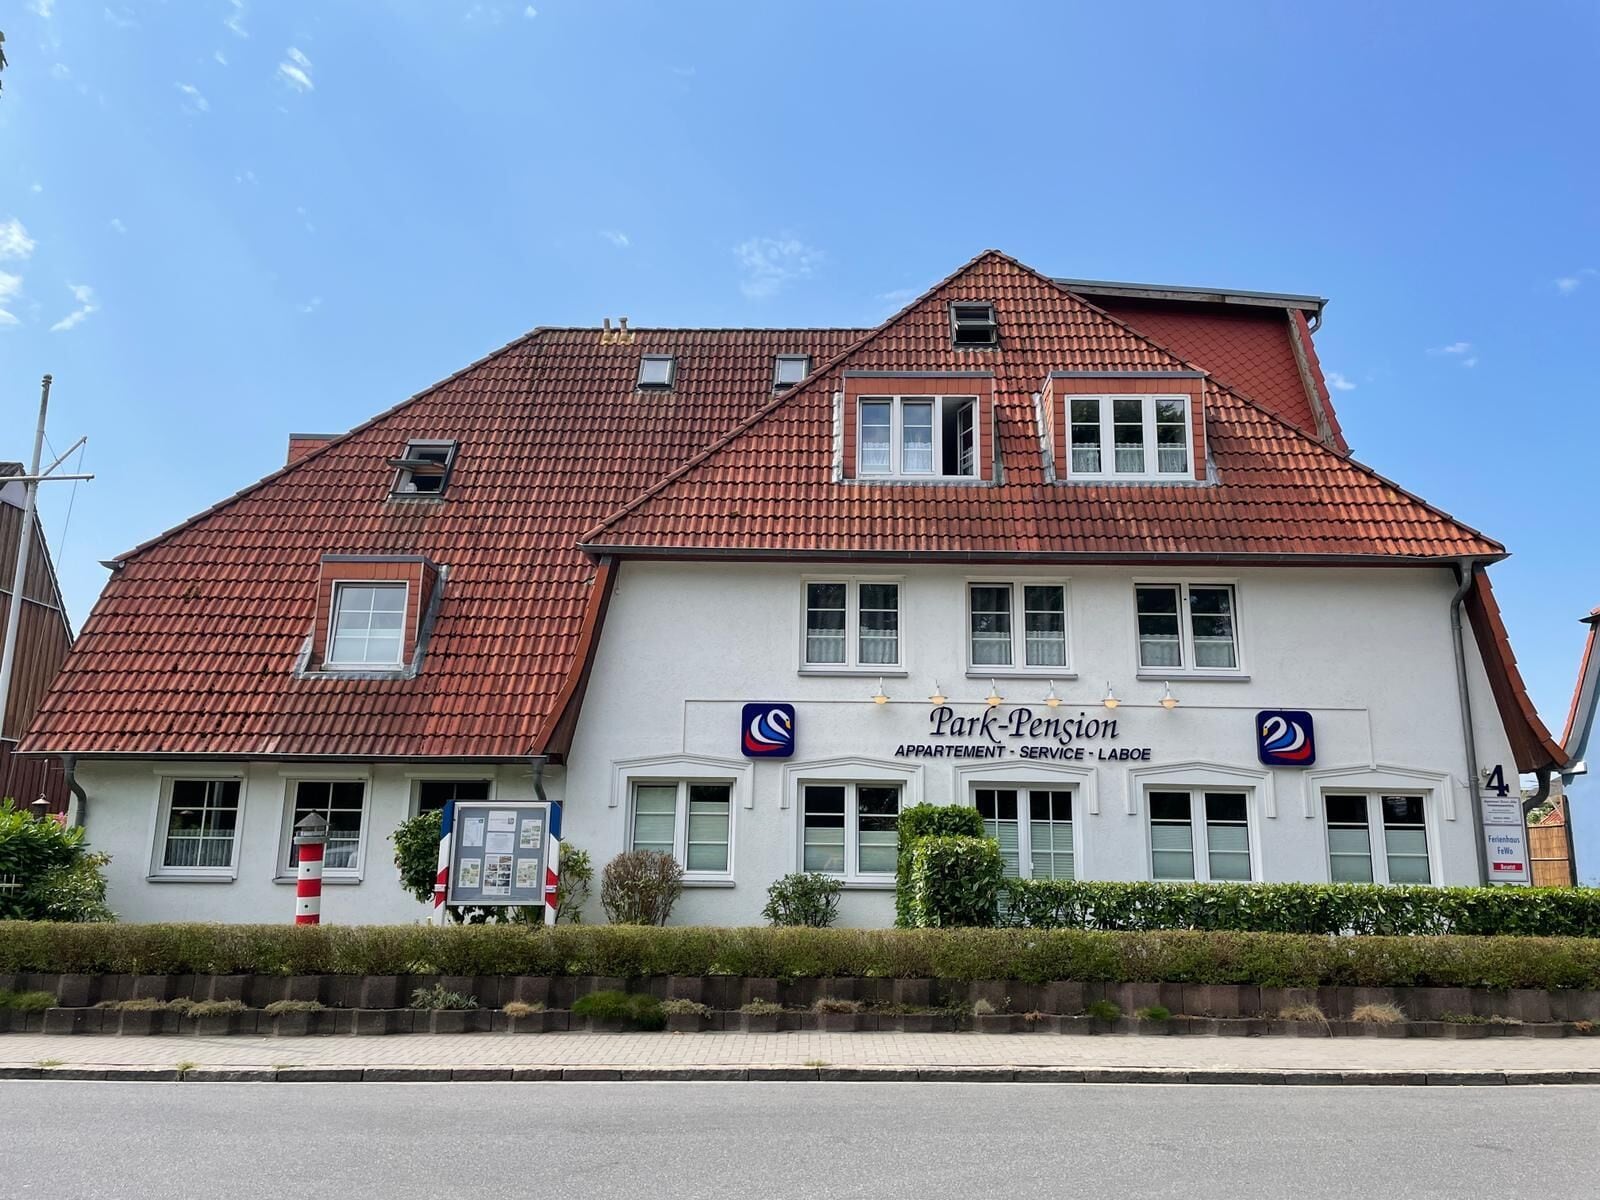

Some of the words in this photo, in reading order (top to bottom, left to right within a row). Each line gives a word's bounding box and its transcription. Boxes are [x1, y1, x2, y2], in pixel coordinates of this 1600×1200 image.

[929, 705, 1120, 745] Park-Pension
[895, 744, 1006, 758] APPARTEMENT
[1019, 745, 1085, 760] SERVICE
[1098, 748, 1151, 760] LABOE
[1485, 765, 1510, 797] 4
[1488, 834, 1520, 844] Ferienhaus
[1497, 846, 1514, 855] FeWo
